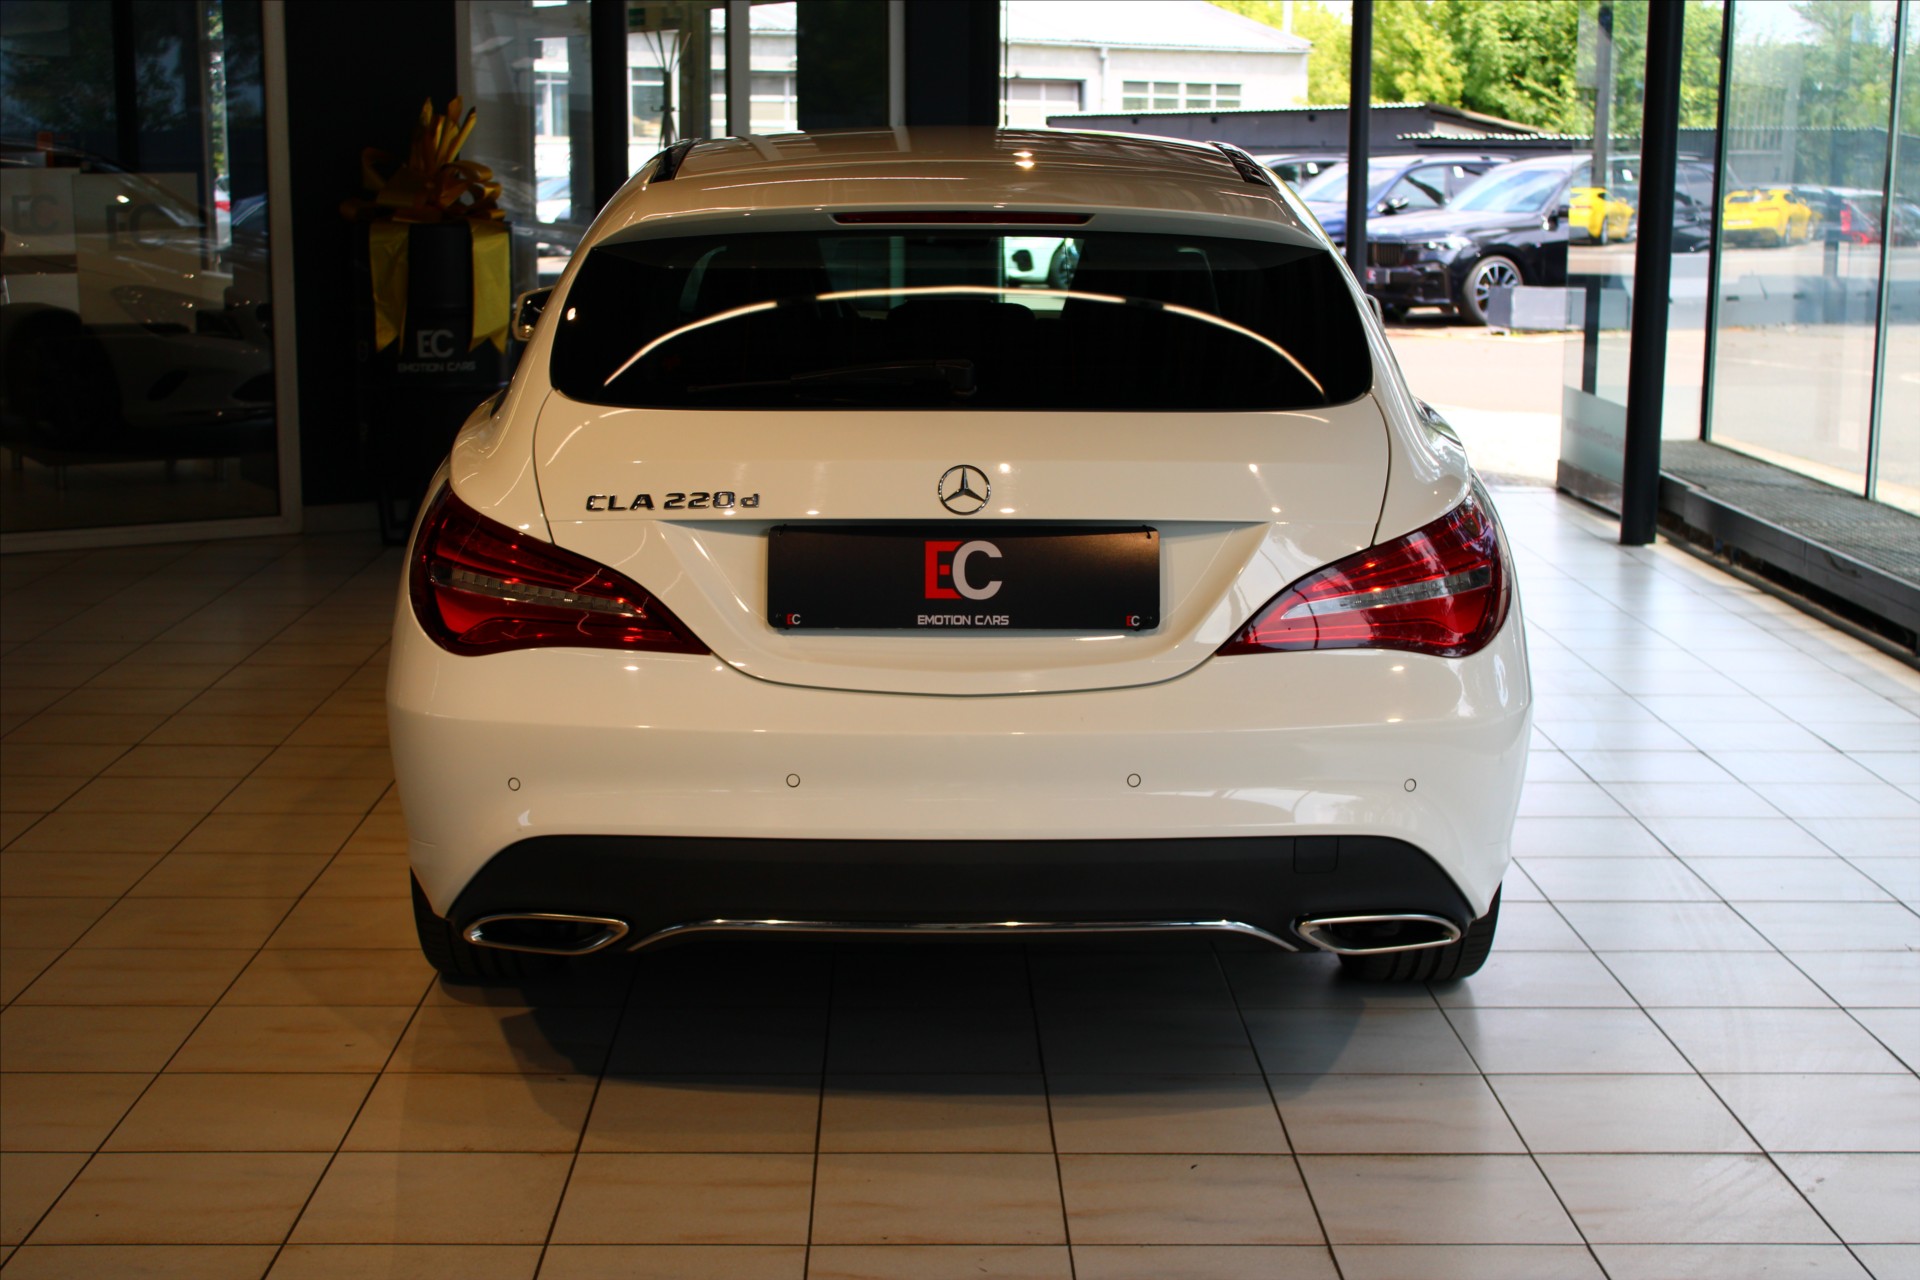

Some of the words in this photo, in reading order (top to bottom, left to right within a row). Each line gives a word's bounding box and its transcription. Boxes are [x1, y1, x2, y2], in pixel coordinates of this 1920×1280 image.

[416, 329, 455, 359] EC
[586, 494, 655, 512] CLA
[924, 540, 1003, 600] EC
[786, 613, 801, 625] EC
[917, 614, 971, 625] EMOTION
[974, 615, 1009, 626] CARS
[1125, 615, 1140, 627] EC
